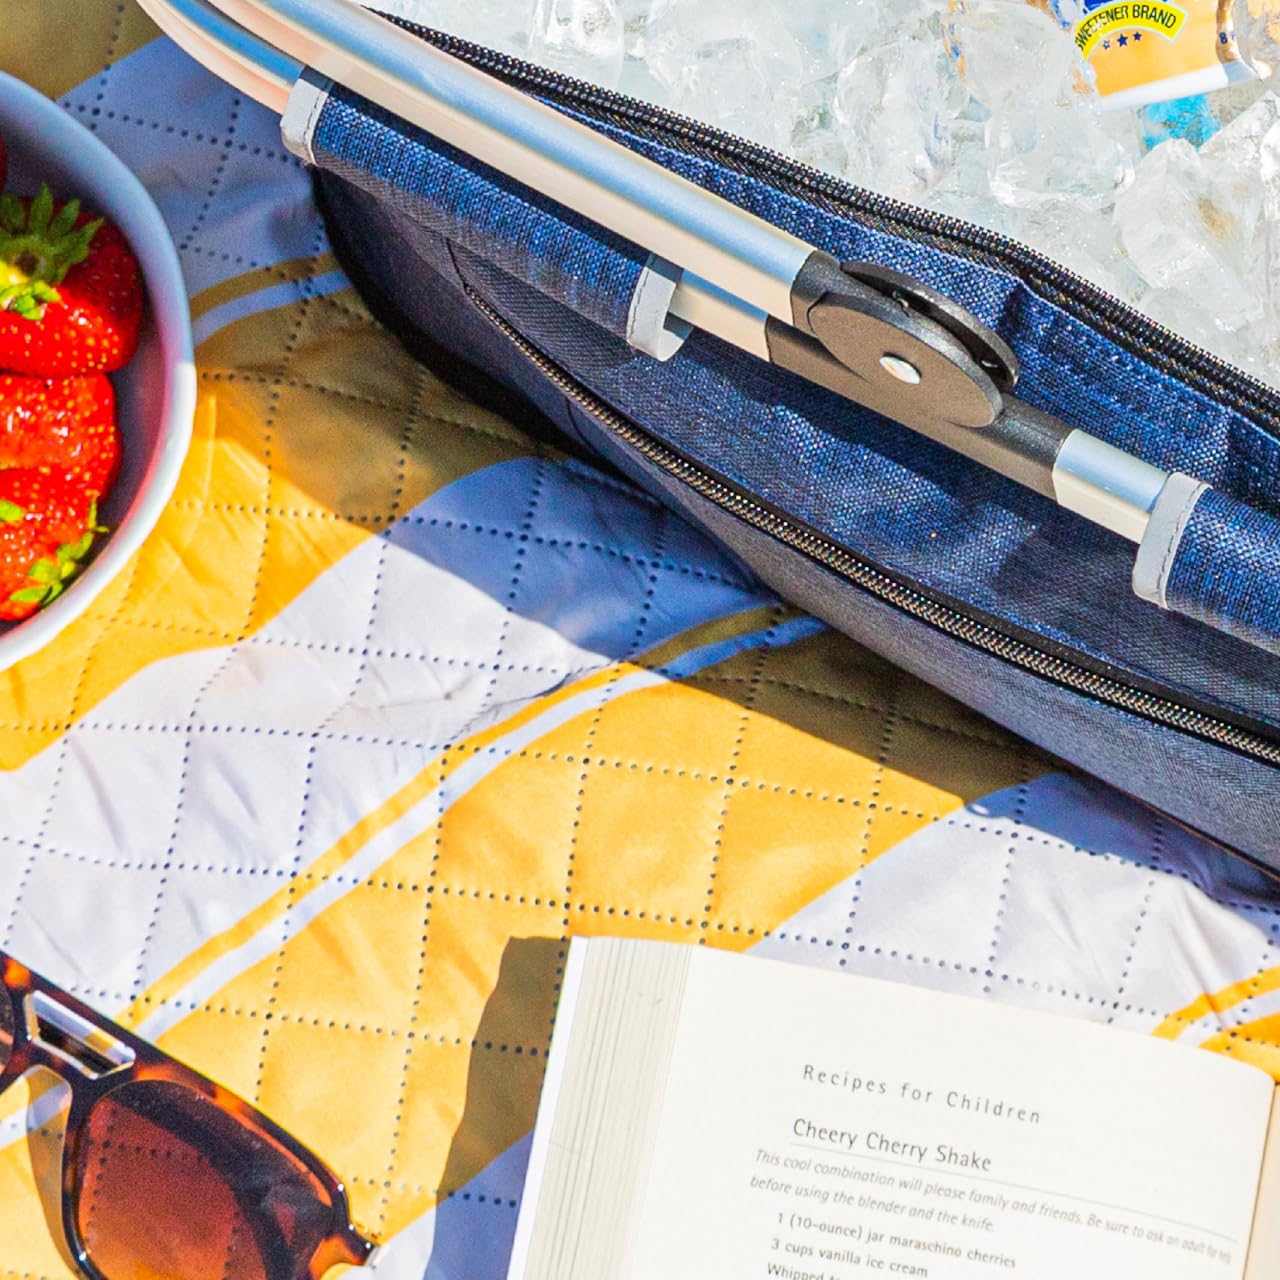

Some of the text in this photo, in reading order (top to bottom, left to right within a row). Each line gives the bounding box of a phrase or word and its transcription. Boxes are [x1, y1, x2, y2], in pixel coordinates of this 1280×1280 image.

[1132, 4, 1176, 29] BRAND
[802, 1064, 1041, 1124] Recipes for Children
[792, 1118, 992, 1172] Cheery Cherry Shake
[750, 1175, 995, 1233] before using the blender and the knife.
[755, 1149, 1130, 1235] This cool combination will please family and friends. Be sure
[771, 1237, 928, 1278] 3 cups vanilla ice cream
[777, 1212, 1017, 1269] 1 (10-ounce) jar maraschino cherries
[766, 1261, 824, 1280] Whipped
